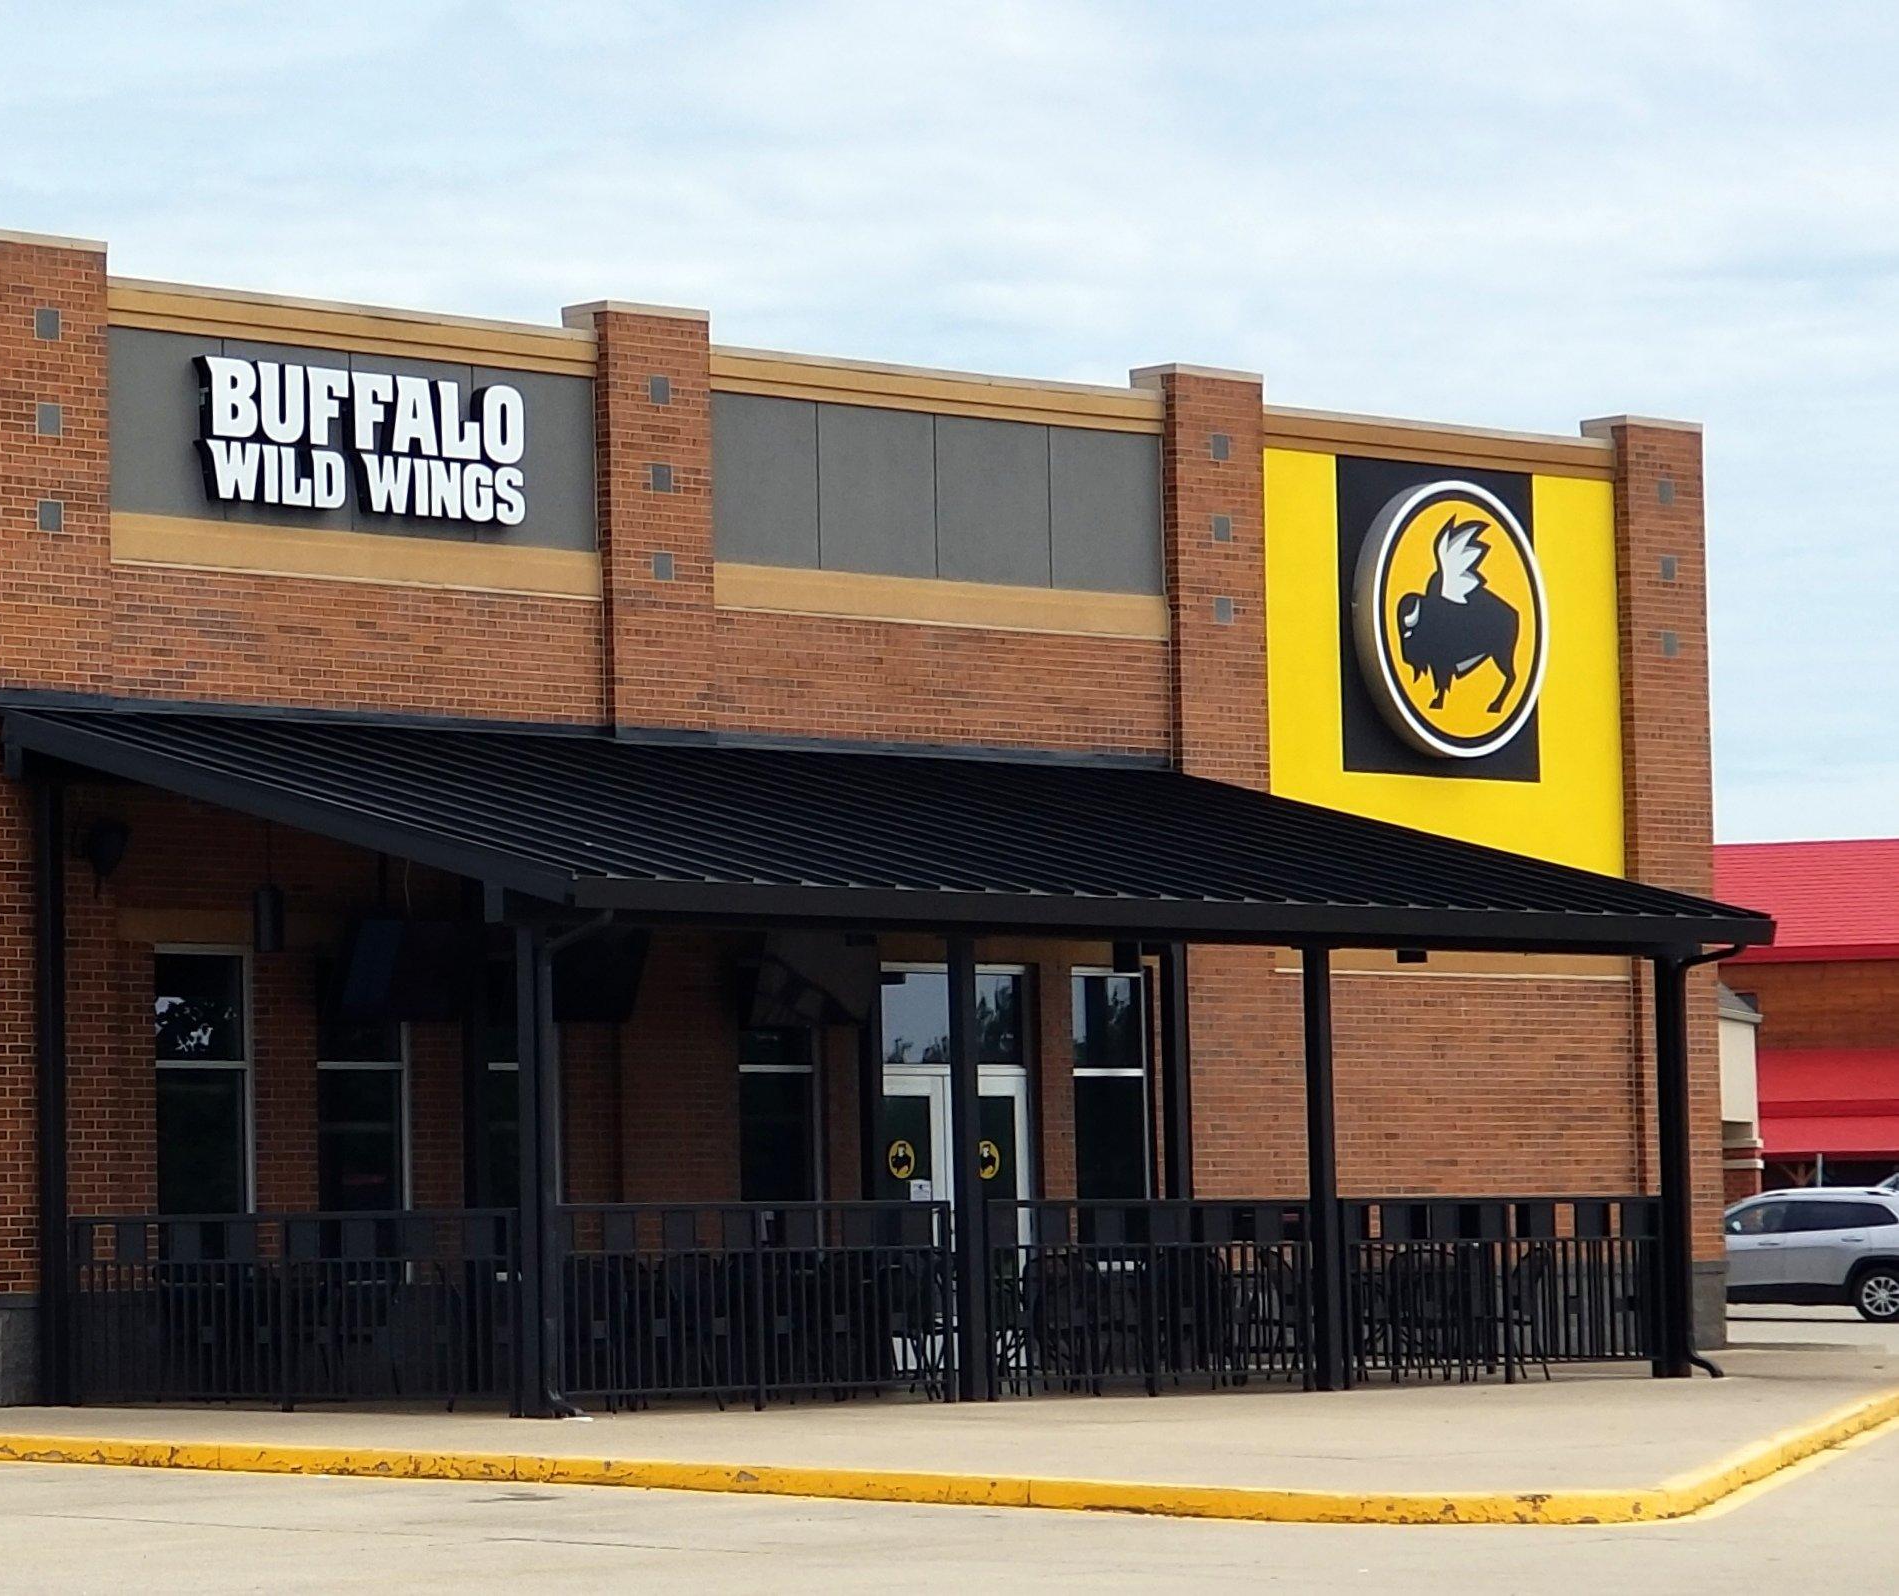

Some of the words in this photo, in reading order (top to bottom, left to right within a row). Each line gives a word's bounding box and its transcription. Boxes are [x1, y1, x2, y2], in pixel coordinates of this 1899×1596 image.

[204, 355, 526, 464] BUFFALO
[206, 438, 346, 510] WILD
[361, 453, 527, 526] WINGS
